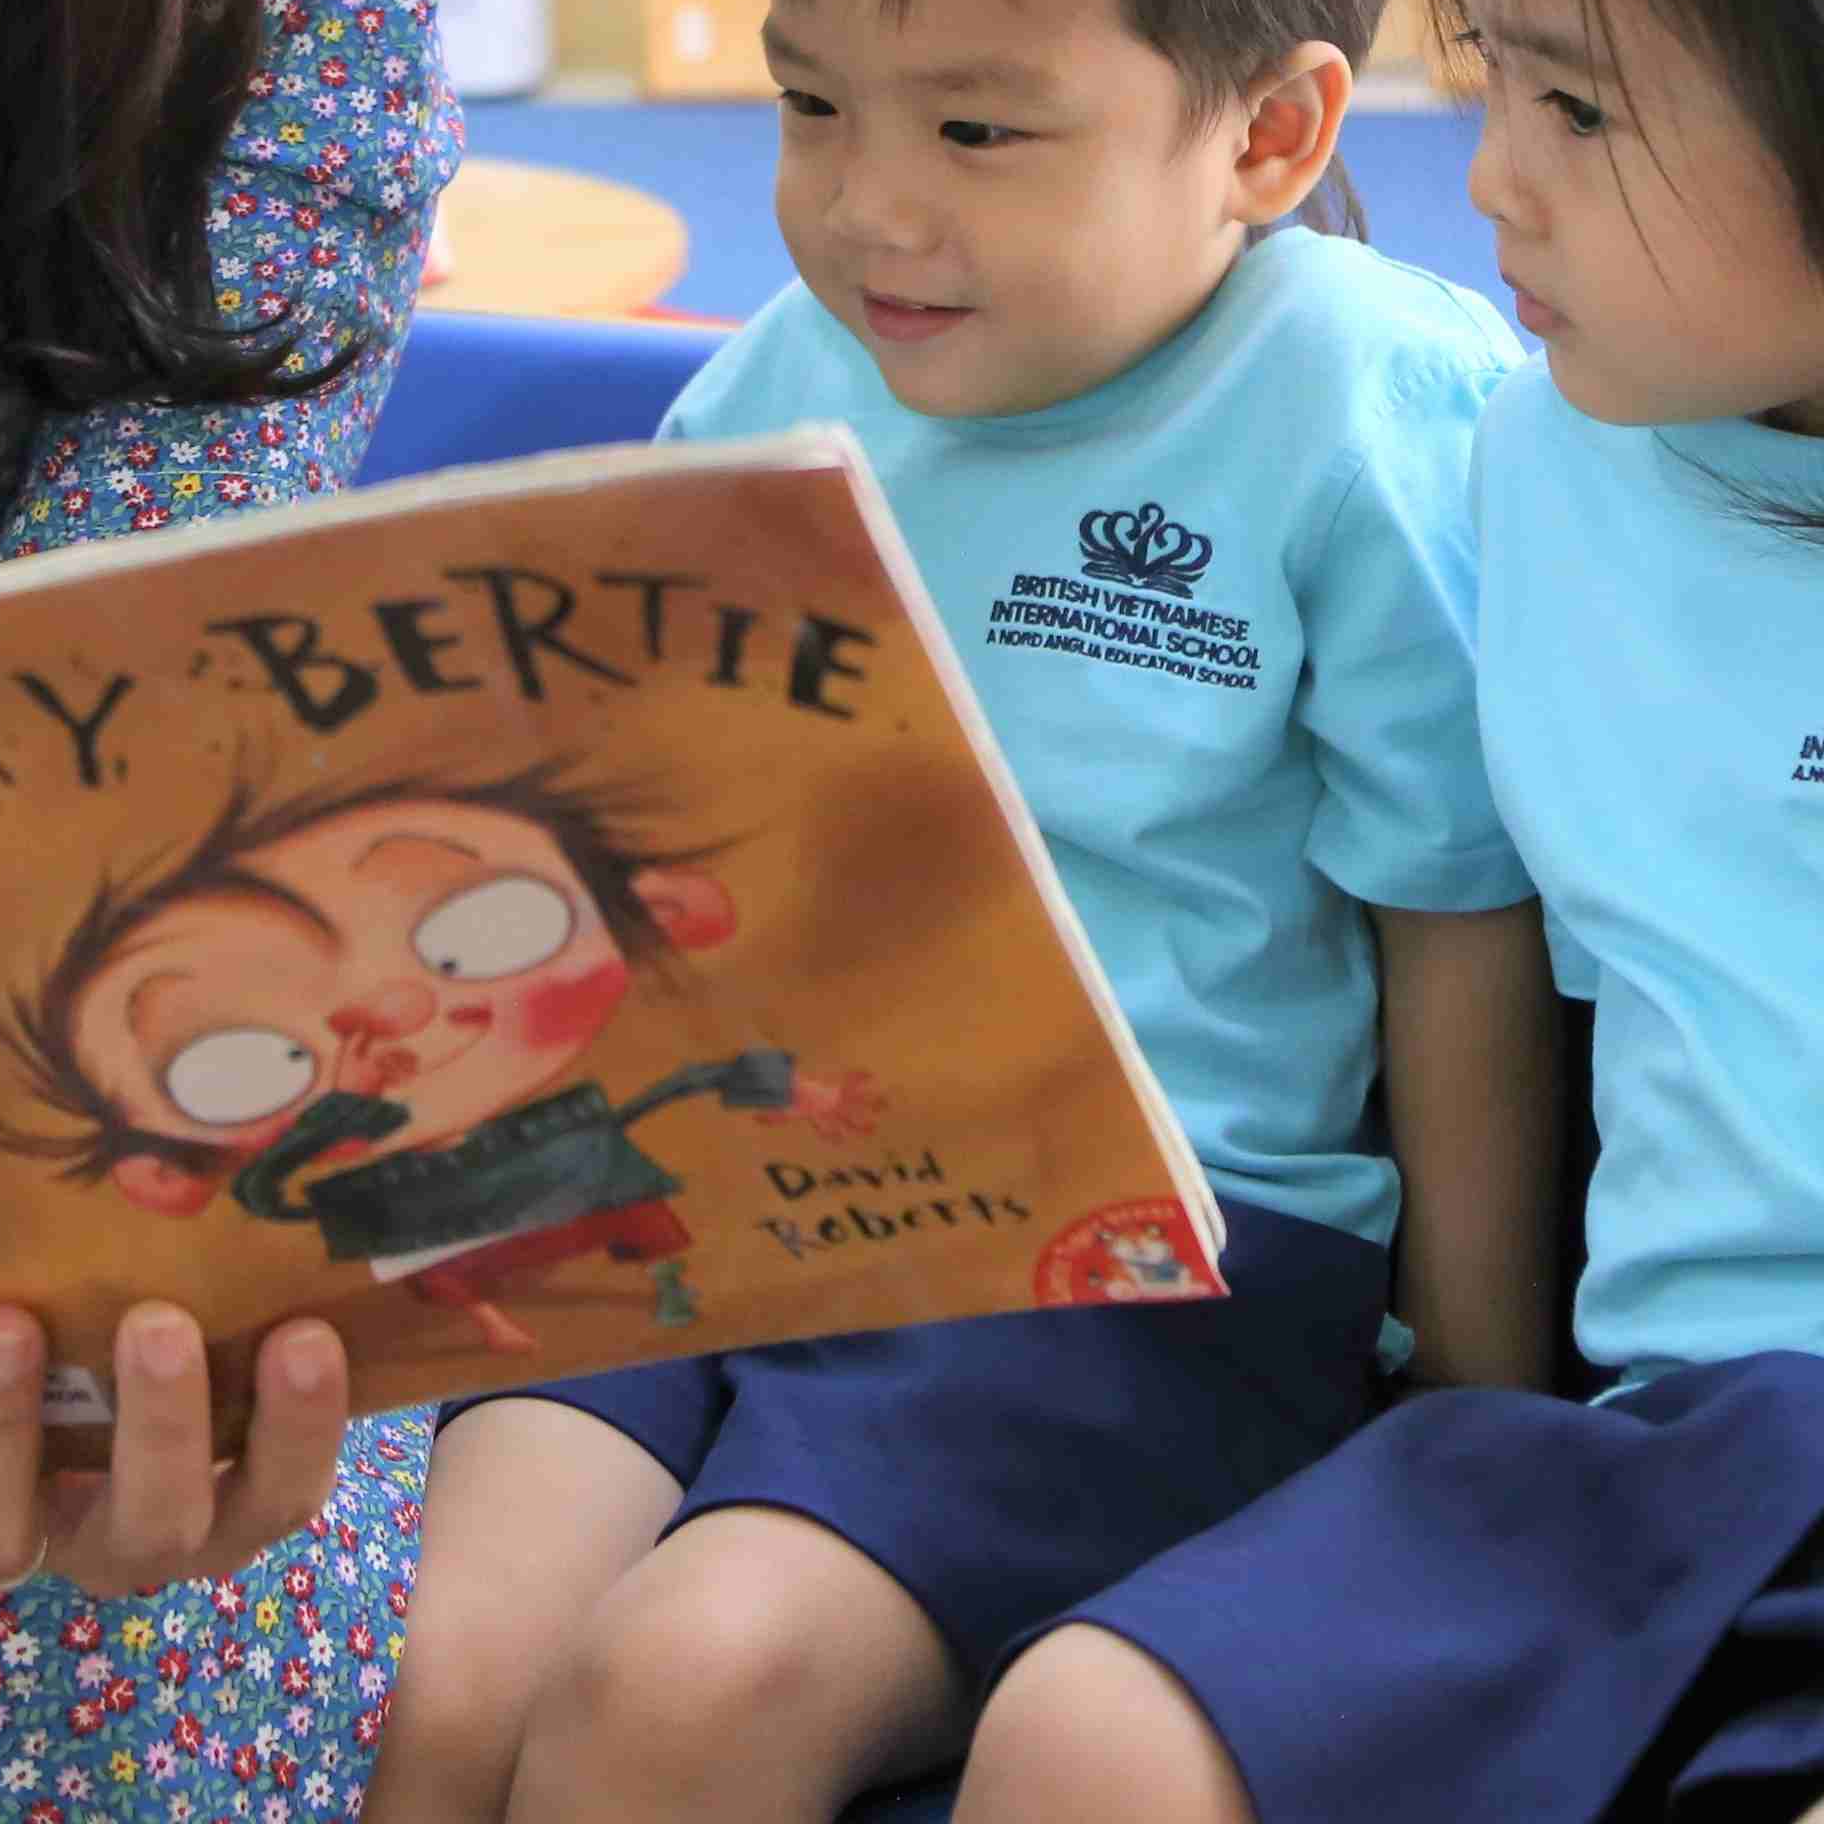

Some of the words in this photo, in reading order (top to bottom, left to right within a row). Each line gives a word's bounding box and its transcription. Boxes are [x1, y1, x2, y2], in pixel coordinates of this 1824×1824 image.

[988, 599, 1163, 651] INTERNATIONAL
[1165, 629, 1262, 670] SCHOOL
[1010, 573, 1100, 608] BRITISH
[1102, 589, 1251, 642] VIETNAMESE
[202, 564, 877, 736] BERTIE
[985, 628, 997, 645] A
[998, 629, 1043, 648] NORD
[1043, 632, 1102, 660] ANGLIA
[1103, 645, 1196, 681] EDUCATION
[1195, 665, 1258, 691] SCHOOL
[763, 1145, 944, 1201] David
